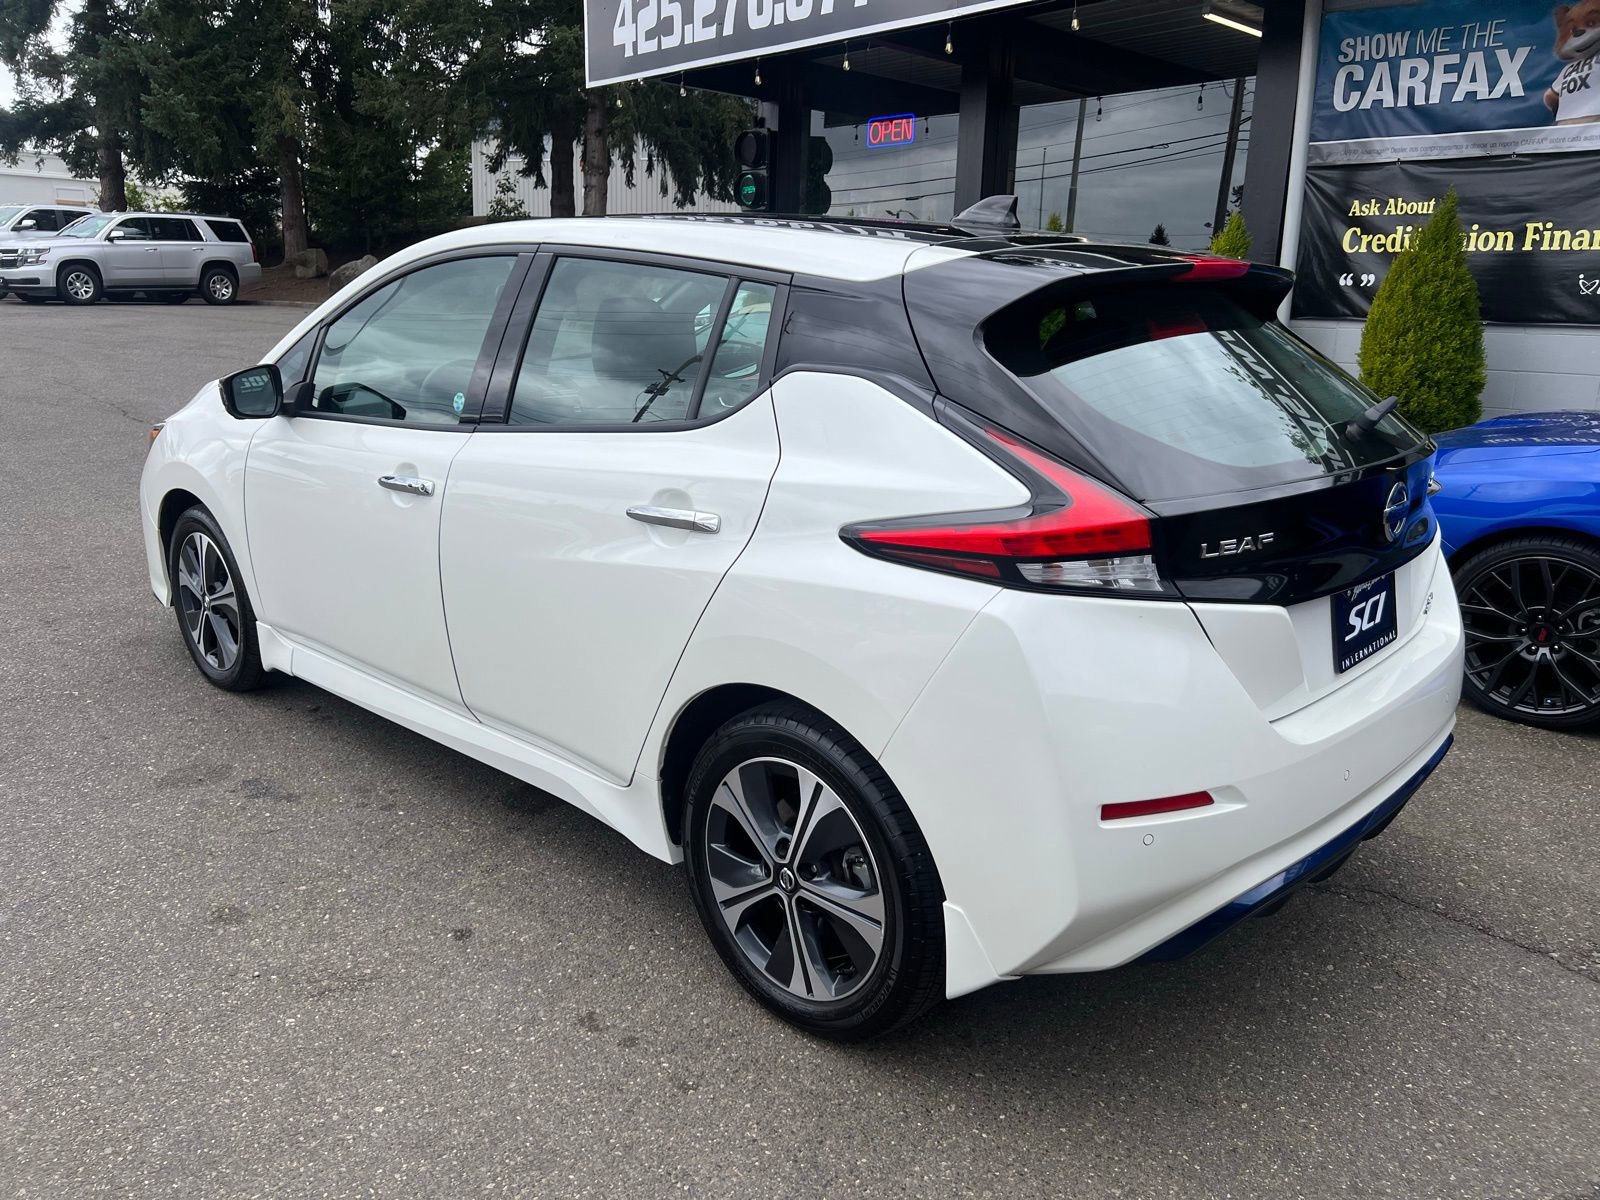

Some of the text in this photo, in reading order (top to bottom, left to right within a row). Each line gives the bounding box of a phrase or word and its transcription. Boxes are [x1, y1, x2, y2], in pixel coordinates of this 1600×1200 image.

[1337, 19, 1507, 63] SHOW ME THE
[1333, 46, 1532, 113] CARFAX
[1560, 72, 1592, 97] FOX
[869, 118, 913, 144] OPEN
[1348, 197, 1436, 217] Ask About
[1342, 225, 1422, 253] Credi
[1458, 223, 1514, 252] ion
[1200, 532, 1274, 559] LEAF
[1344, 590, 1387, 642] SCI
[1342, 629, 1397, 670] INTERNATIONAL
